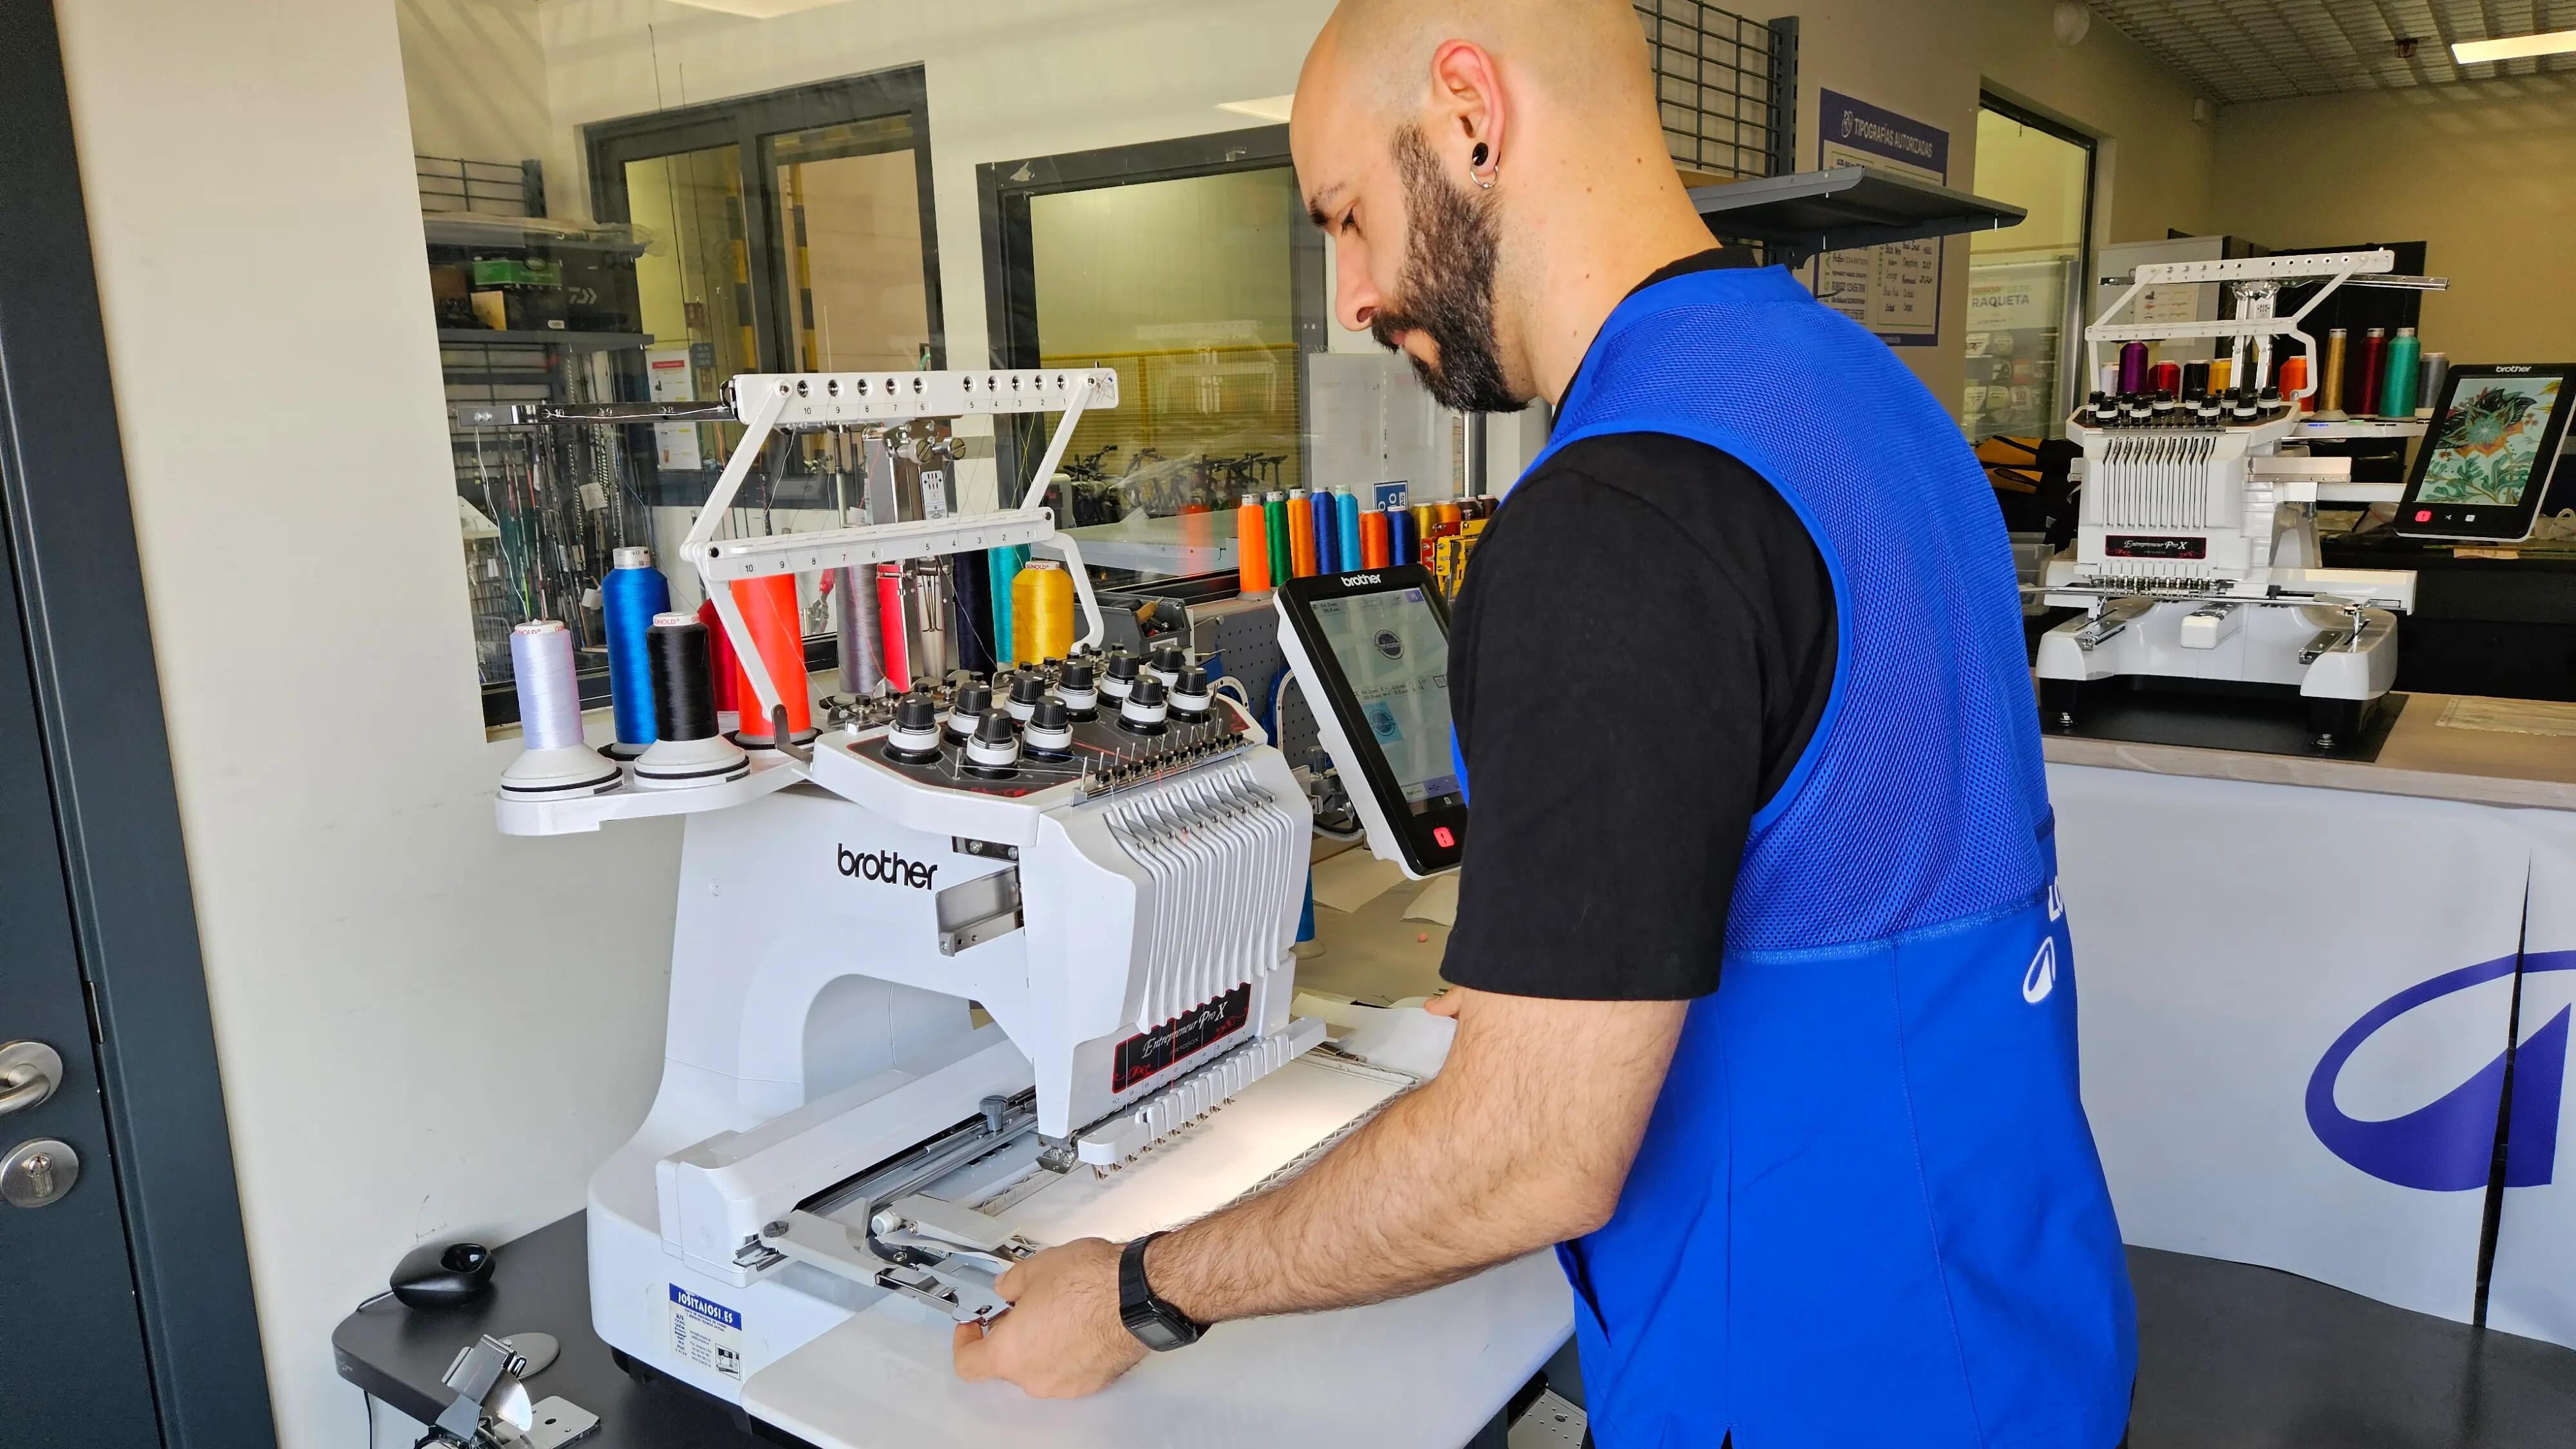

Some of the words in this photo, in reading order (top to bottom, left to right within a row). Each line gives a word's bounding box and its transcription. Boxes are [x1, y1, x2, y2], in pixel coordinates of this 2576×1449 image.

[1854, 117, 1894, 147] TIPOGRAFÍAS
[1893, 131, 1933, 158] AUTORIZADAS
[1971, 294, 2030, 308] RAQUETA
[2123, 540, 2164, 548] Entrepreneur
[2164, 541, 2179, 549] Pro
[2177, 541, 2188, 550] X
[745, 564, 753, 573] 10
[1340, 574, 1381, 587] brother
[837, 842, 938, 891] brother
[1141, 1020, 1198, 1059] Entrepreneur
[1198, 1010, 1216, 1030] Pro
[1215, 1000, 1229, 1022] X
[677, 1291, 733, 1323] JOSITAJOSI.ES
